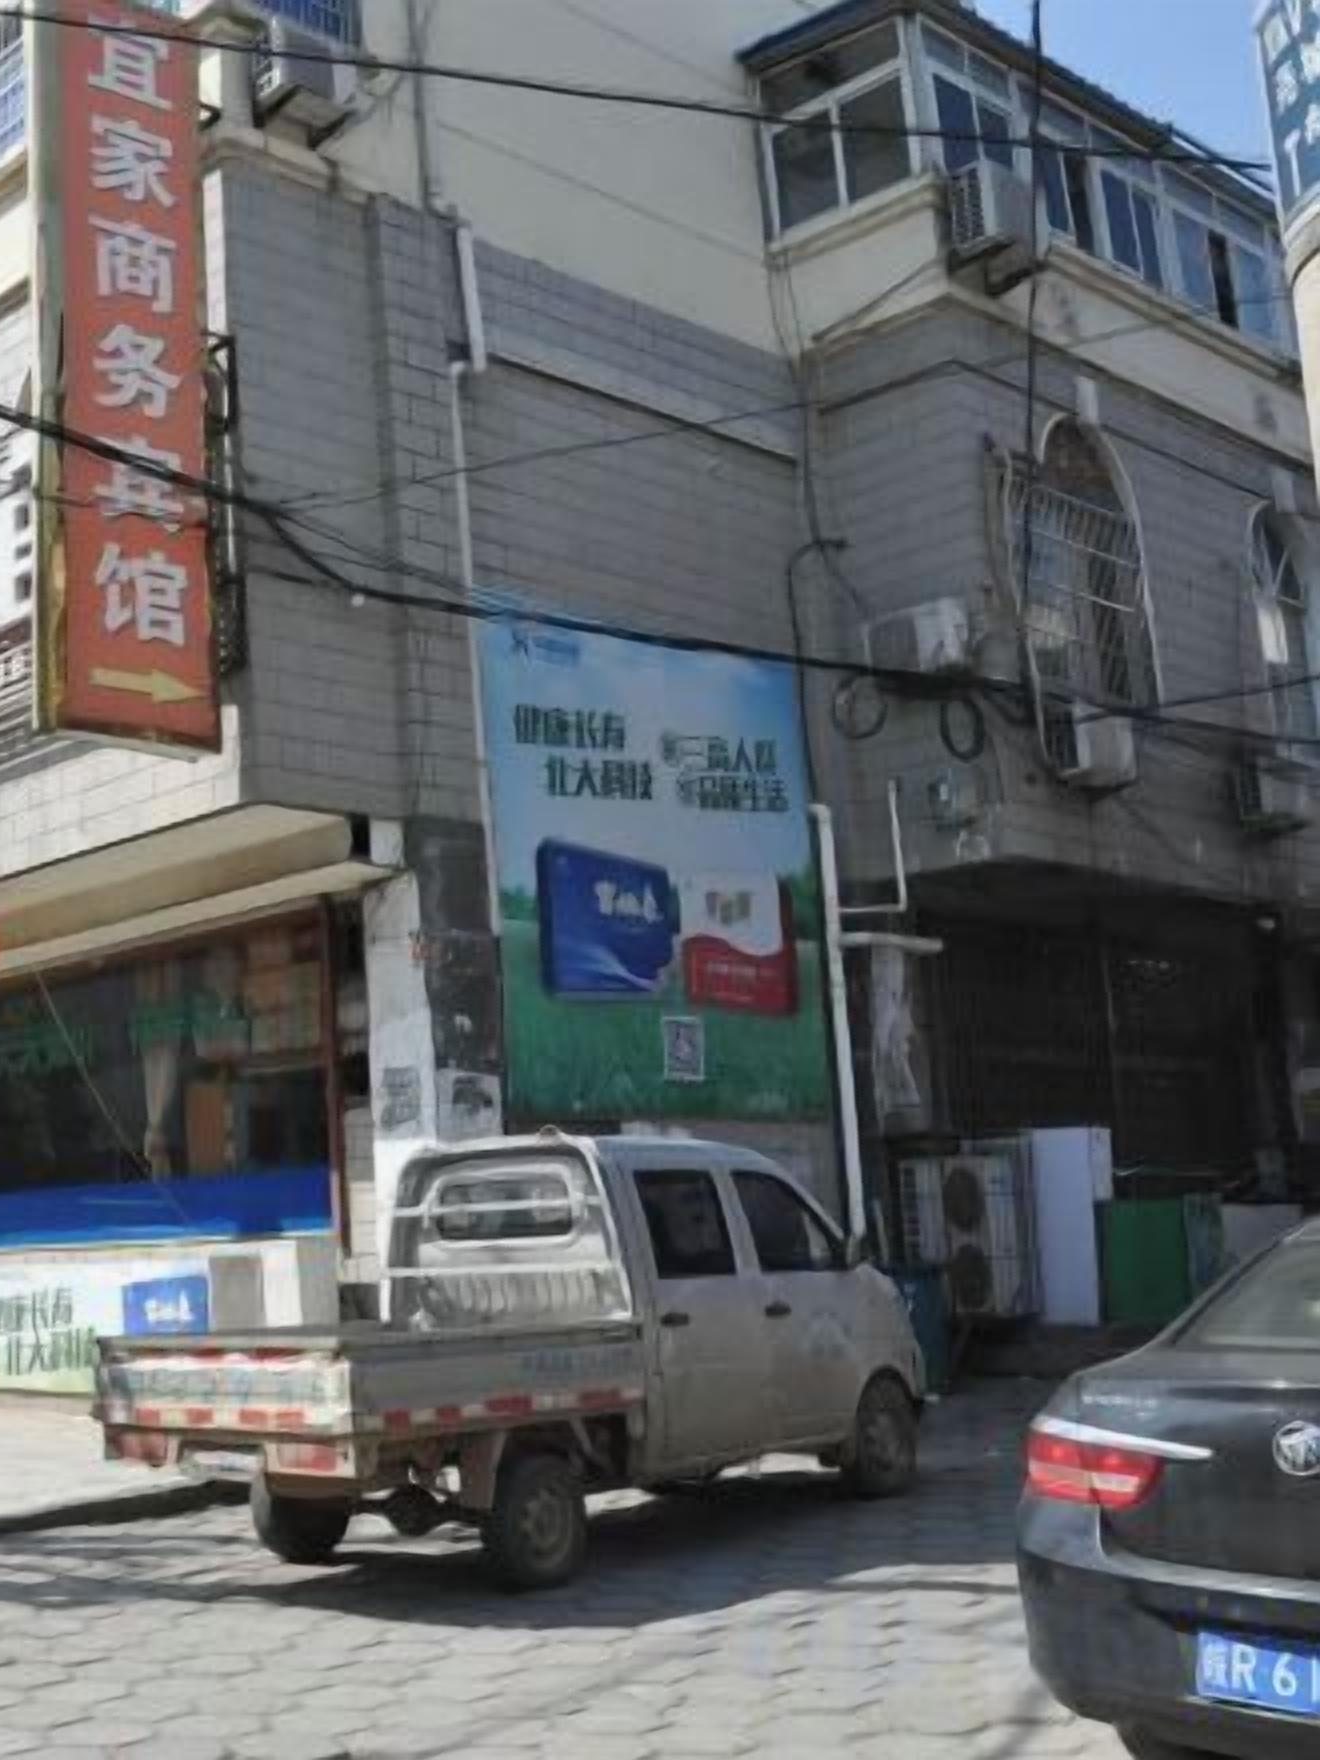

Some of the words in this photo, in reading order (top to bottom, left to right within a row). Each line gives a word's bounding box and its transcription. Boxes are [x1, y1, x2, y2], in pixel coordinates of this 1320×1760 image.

[86, 15, 188, 646] 宜家商务宾馆
